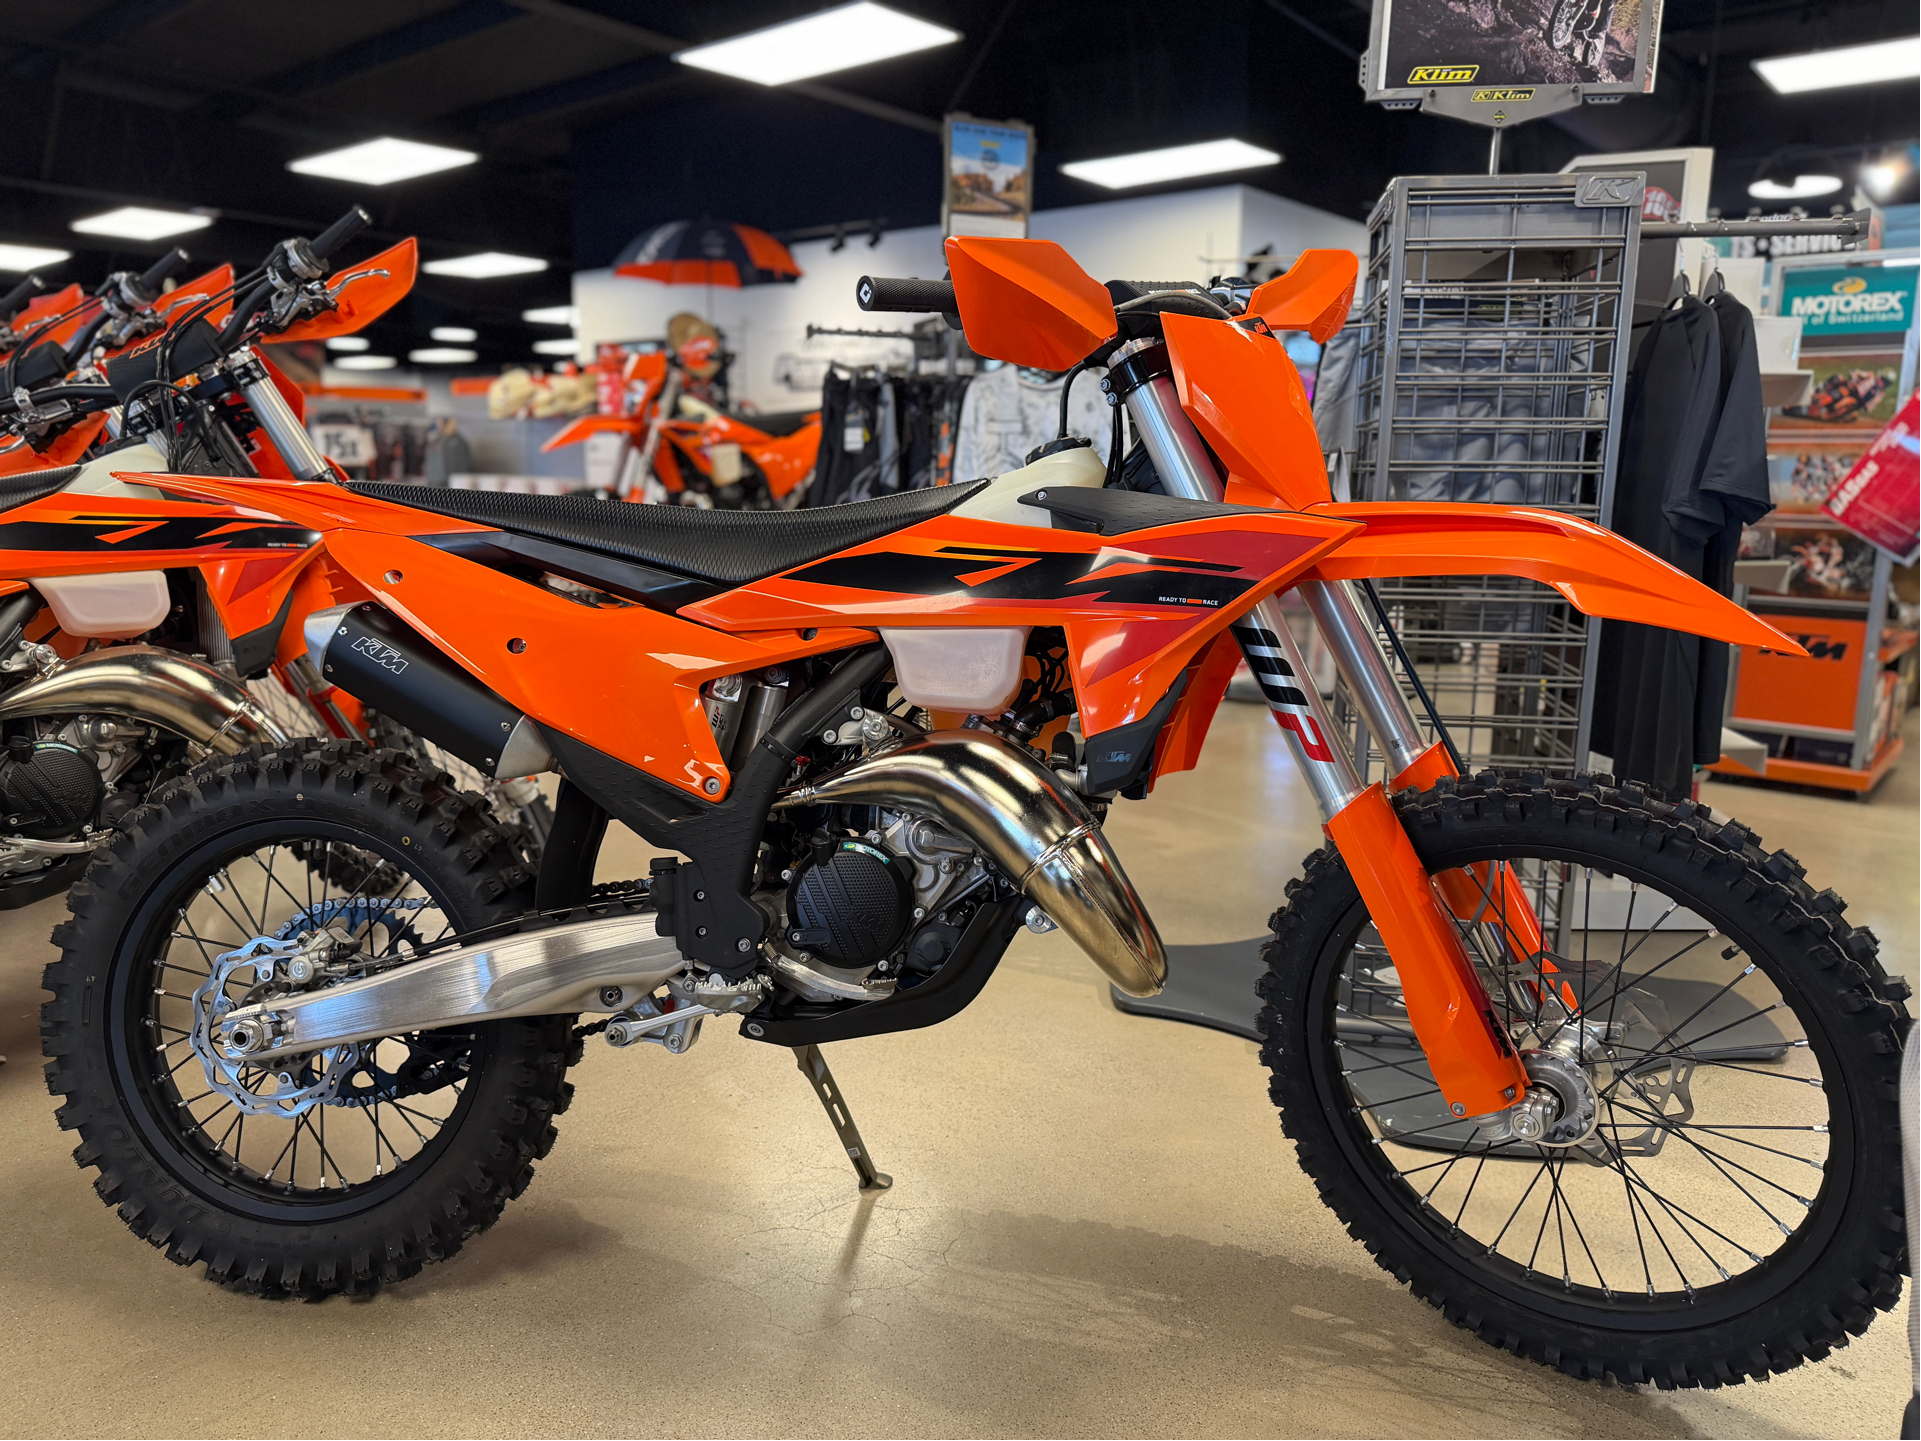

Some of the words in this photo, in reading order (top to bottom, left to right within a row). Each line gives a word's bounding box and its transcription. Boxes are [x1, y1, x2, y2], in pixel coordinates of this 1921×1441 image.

[1411, 68, 1473, 81] Klim
[1791, 291, 1906, 316] MOTOREX
[351, 636, 410, 675] KTM
[1096, 750, 1132, 763] KTM
[856, 844, 890, 864] MOTOREX
